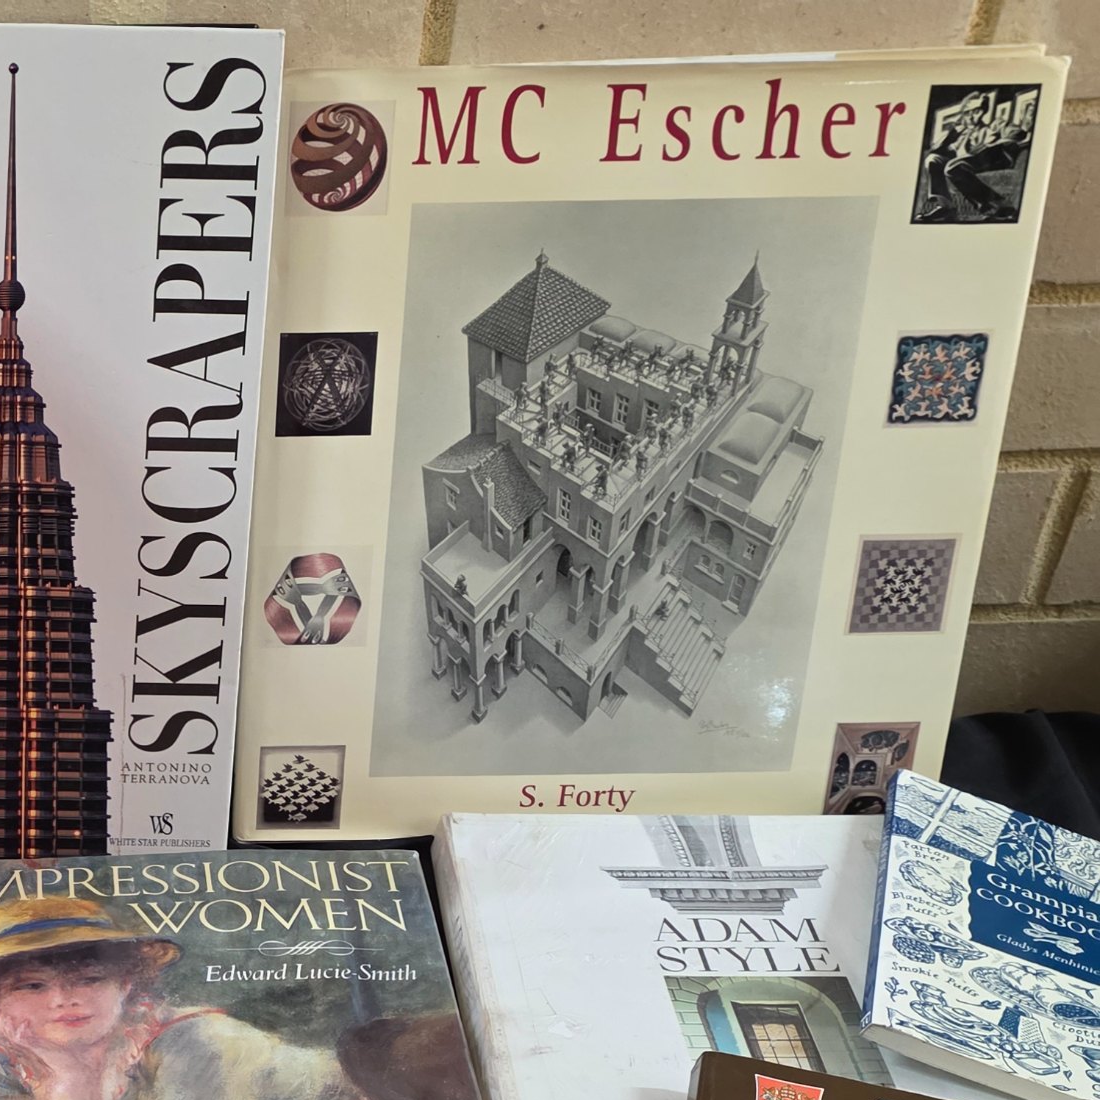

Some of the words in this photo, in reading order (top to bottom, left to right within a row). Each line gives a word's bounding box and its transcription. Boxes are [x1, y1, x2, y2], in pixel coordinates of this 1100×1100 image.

[412, 84, 546, 165] MC
[599, 78, 907, 163] Escher
[128, 57, 267, 755] SKYSCRAPERS
[121, 762, 211, 774] ANTONINO
[121, 774, 210, 785] TERRANOVA
[519, 784, 544, 808] S.
[556, 784, 636, 813] Forty
[109, 838, 136, 847] WHITE
[138, 839, 158, 847] STAR
[160, 839, 211, 848] PUBLISHERS
[128, 898, 407, 934] WOMEN
[653, 917, 826, 943] ADAM
[997, 933, 1038, 954] Gladys
[656, 946, 841, 973] STYLE
[205, 963, 288, 983] Edward
[293, 963, 417, 982] Lucie-Smith
